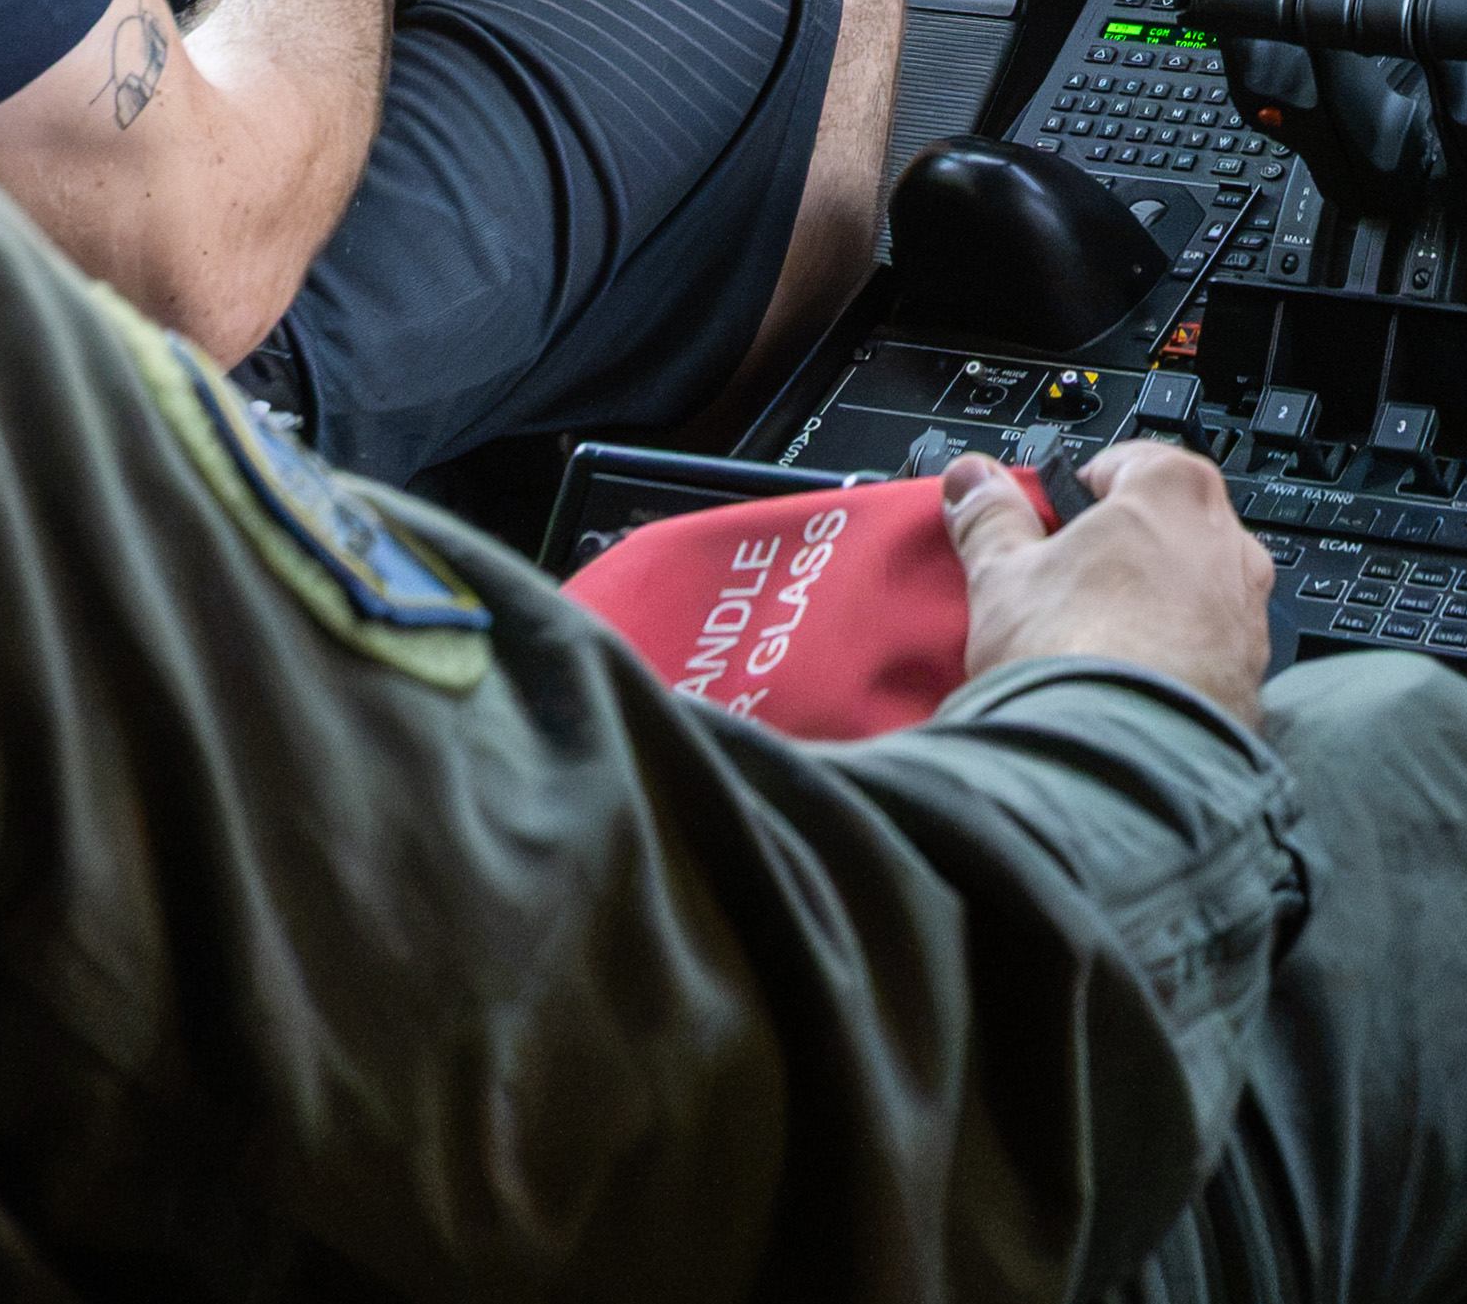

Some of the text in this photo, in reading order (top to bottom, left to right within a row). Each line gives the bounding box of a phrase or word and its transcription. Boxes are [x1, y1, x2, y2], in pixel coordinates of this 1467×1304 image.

[1277, 405, 1288, 418] 2
[1396, 420, 1407, 433] 3
[1319, 539, 1362, 555] ECAM
[747, 509, 847, 676] GLASS
[674, 535, 781, 699] ANDLE
